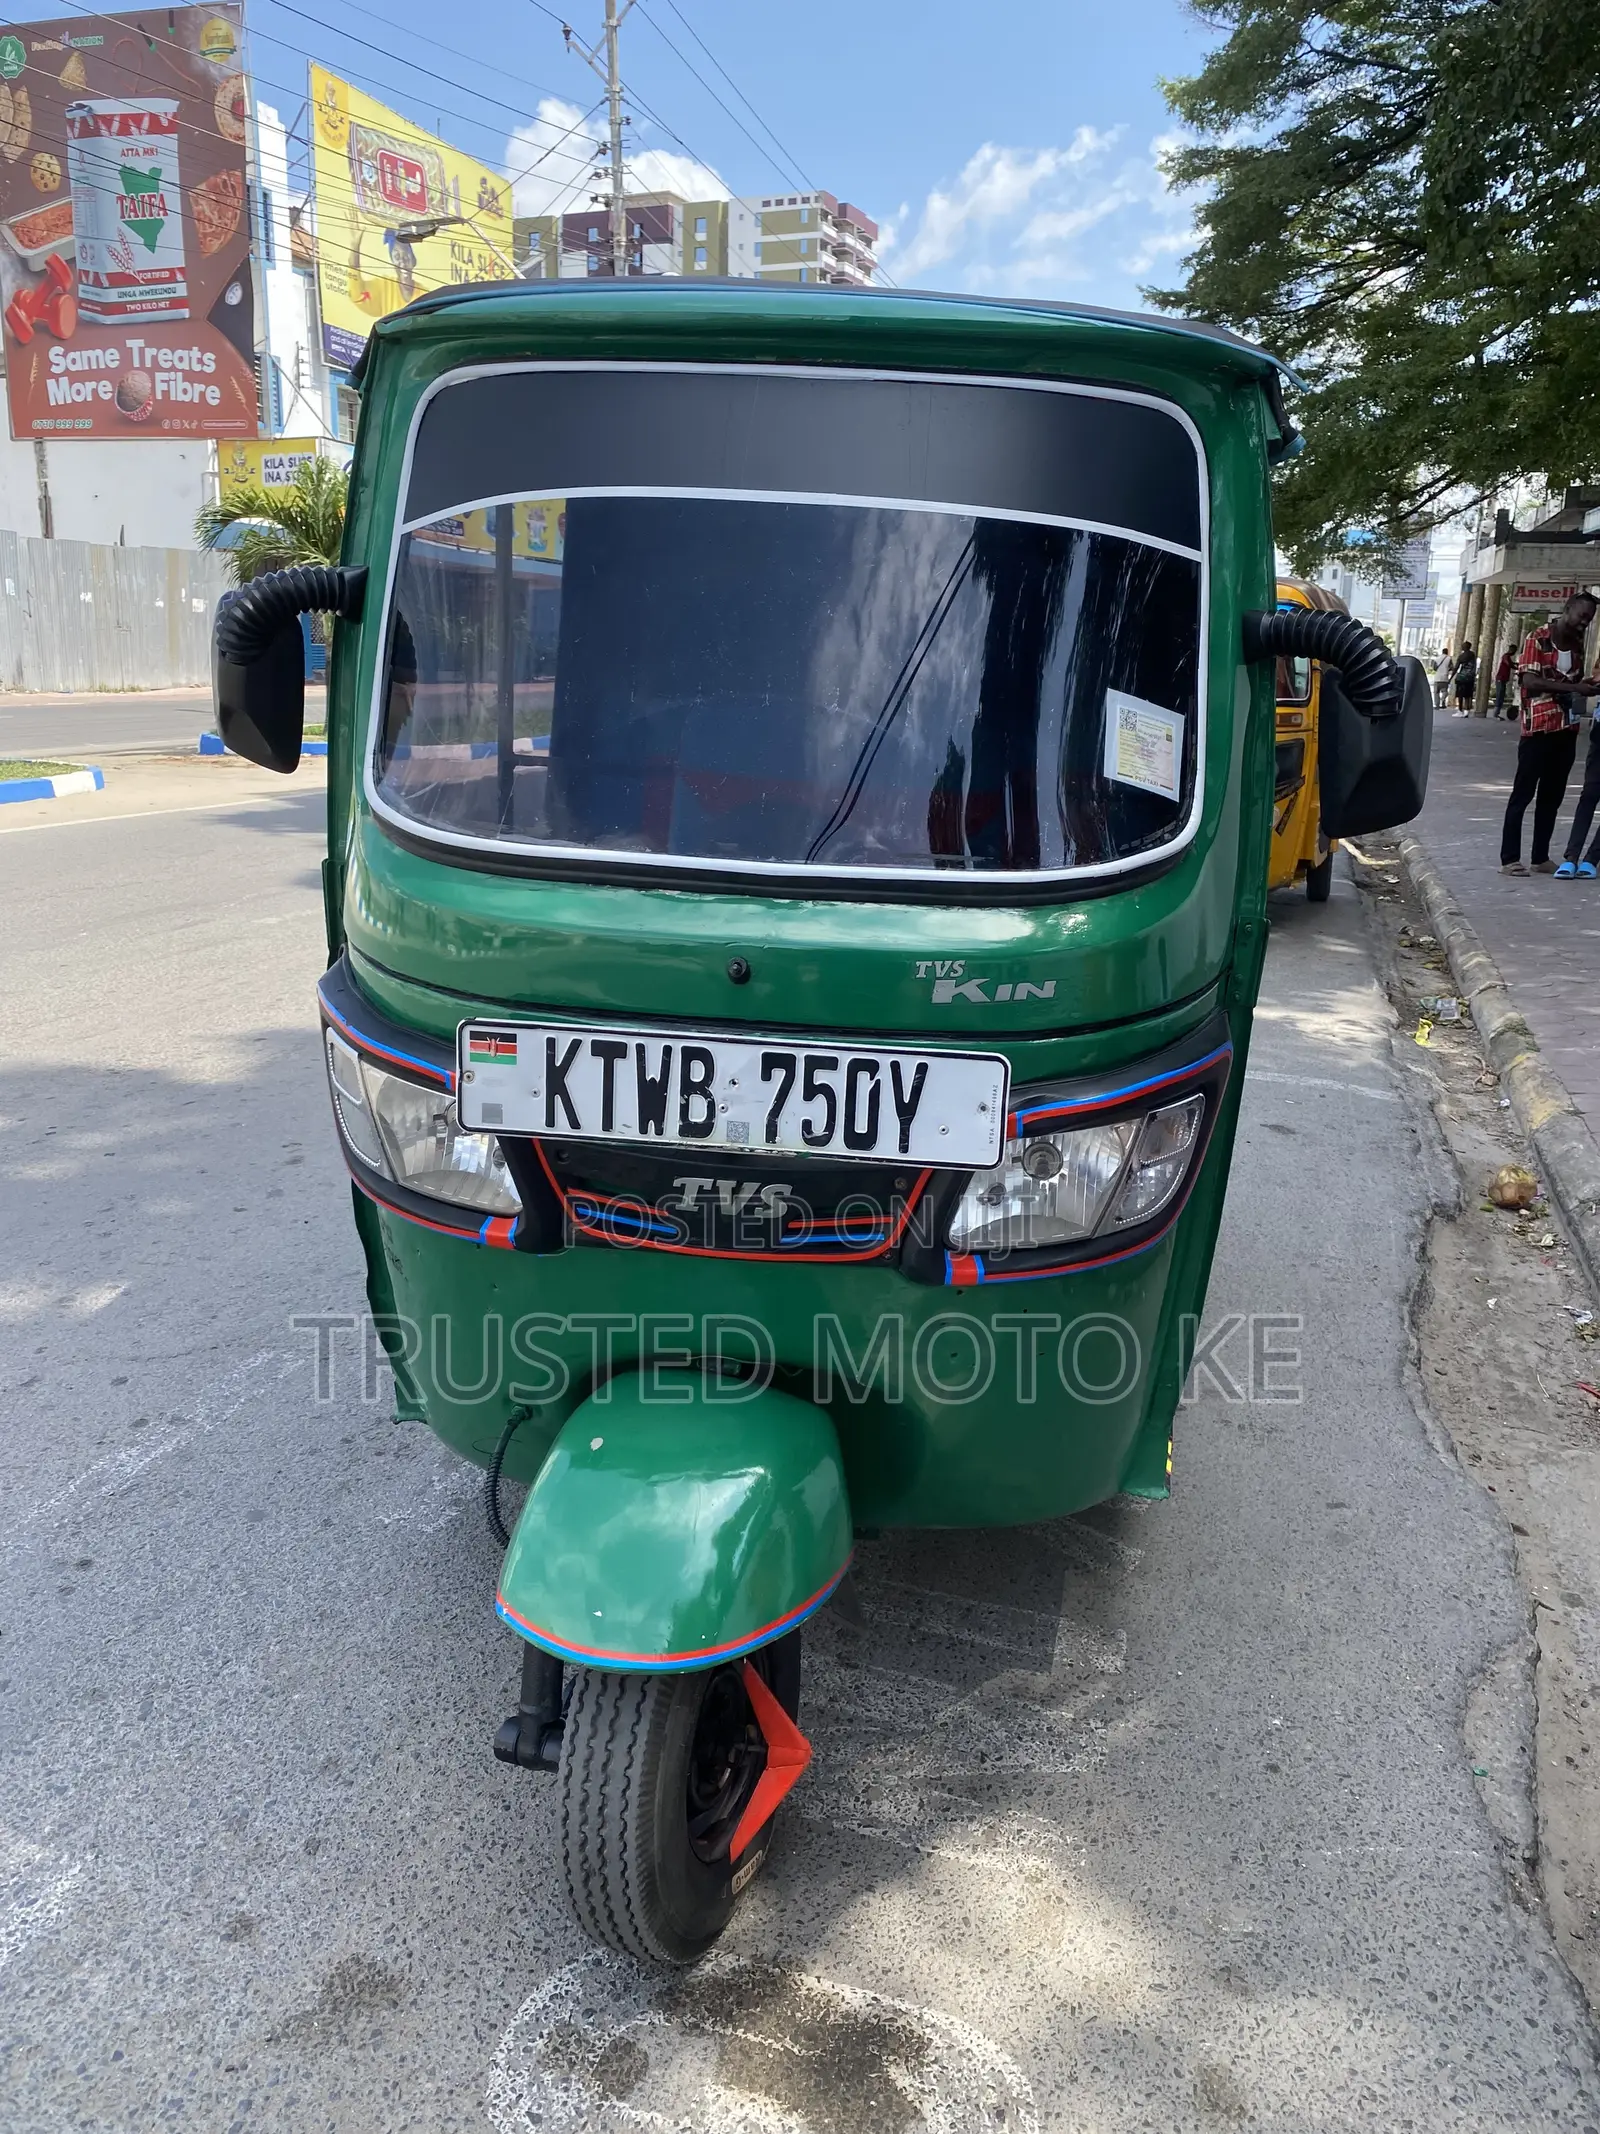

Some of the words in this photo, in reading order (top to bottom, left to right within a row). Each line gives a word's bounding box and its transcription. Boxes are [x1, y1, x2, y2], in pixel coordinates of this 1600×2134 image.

[120, 148, 140, 157] ATTA
[116, 193, 169, 220] TAIFA
[450, 239, 475, 269] KILA
[117, 289, 137, 299] UNGA
[126, 303, 141, 311] TWO
[49, 345, 120, 374] Same
[125, 338, 217, 374] Treats
[46, 376, 113, 407] More
[155, 371, 221, 406] Fibre
[264, 456, 285, 469] KILA
[264, 470, 282, 483] INA
[1514, 585, 1576, 598] Ansell
[916, 960, 966, 978] TVS
[545, 1036, 717, 1139] KTWB
[760, 1051, 929, 1154] 750Y
[673, 1177, 793, 1218] TVS
